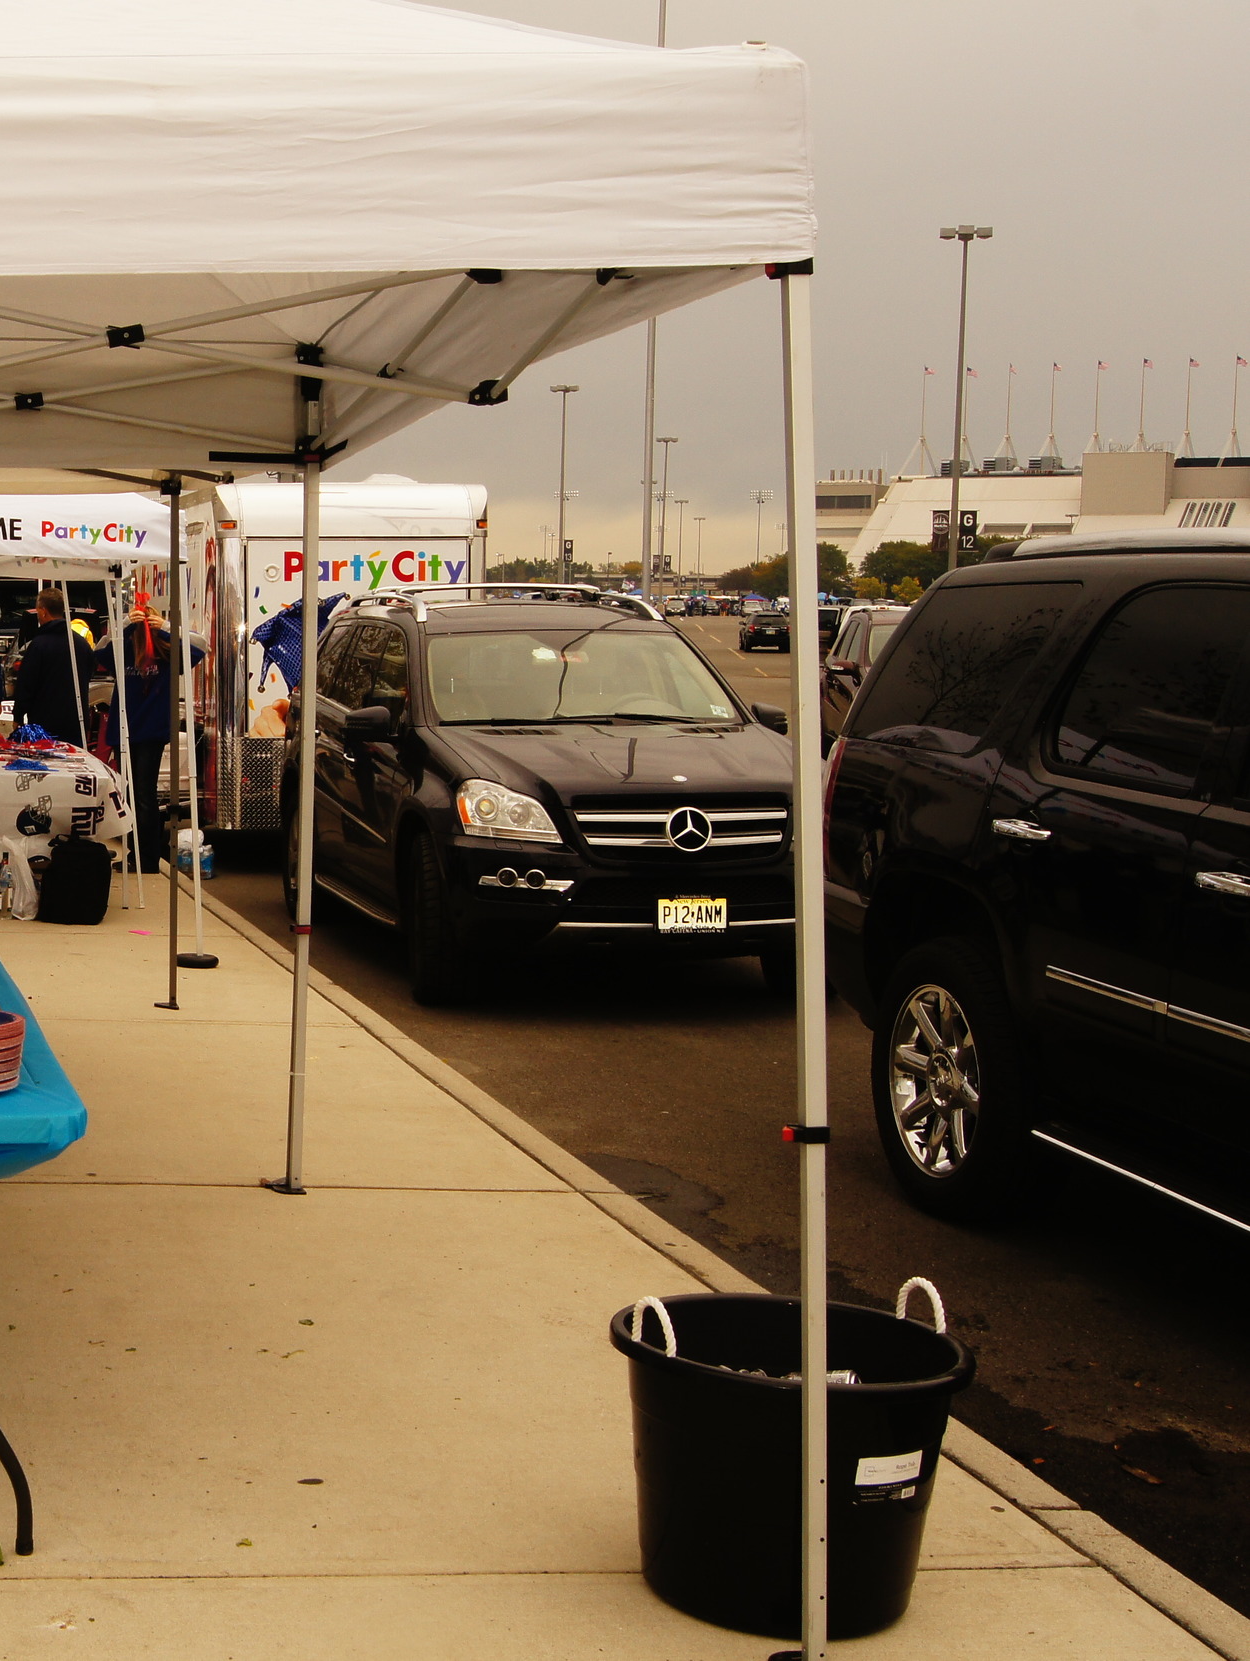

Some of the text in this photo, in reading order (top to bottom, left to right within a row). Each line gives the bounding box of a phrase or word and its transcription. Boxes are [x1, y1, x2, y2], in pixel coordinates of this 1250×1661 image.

[963, 514, 974, 527] G
[565, 541, 571, 549] G
[961, 535, 974, 548] 12
[564, 553, 572, 561] 13
